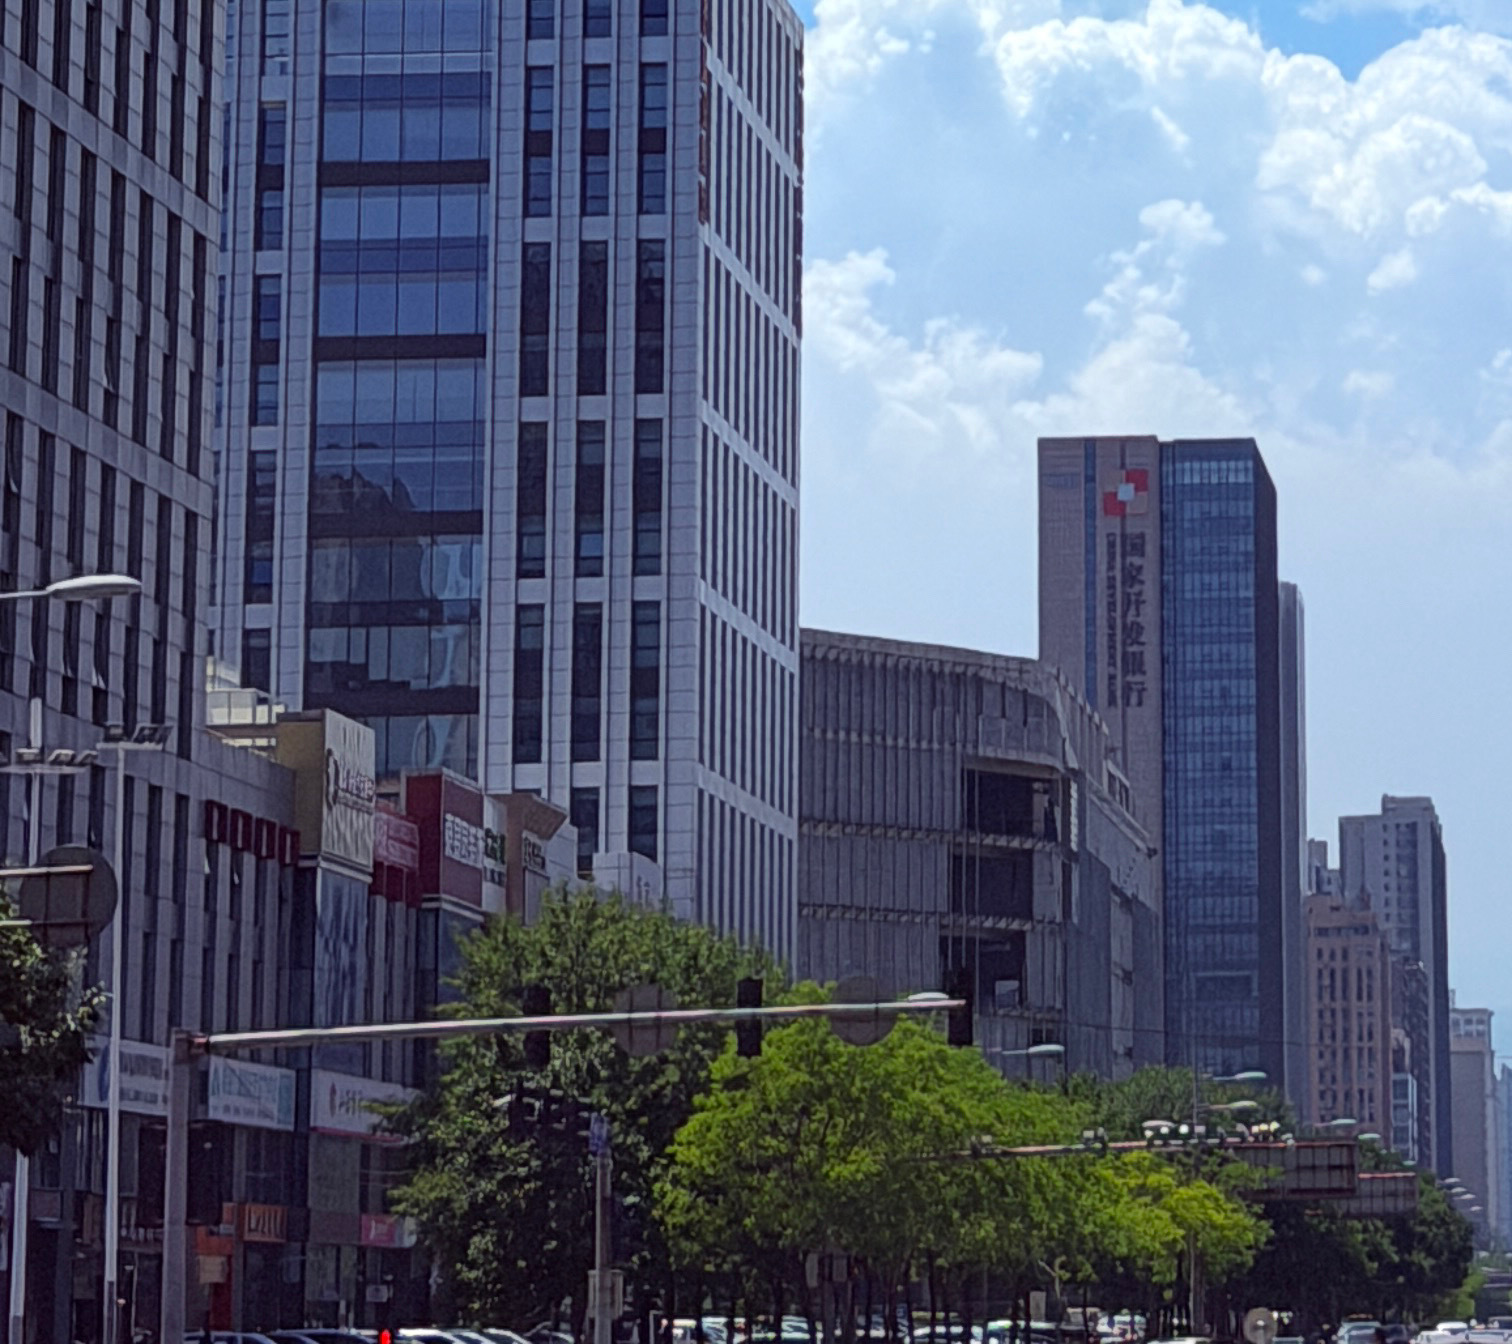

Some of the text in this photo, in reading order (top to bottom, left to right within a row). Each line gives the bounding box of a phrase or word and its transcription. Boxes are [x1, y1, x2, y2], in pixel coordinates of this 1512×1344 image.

[1124, 531, 1147, 708] 国家开发银行
